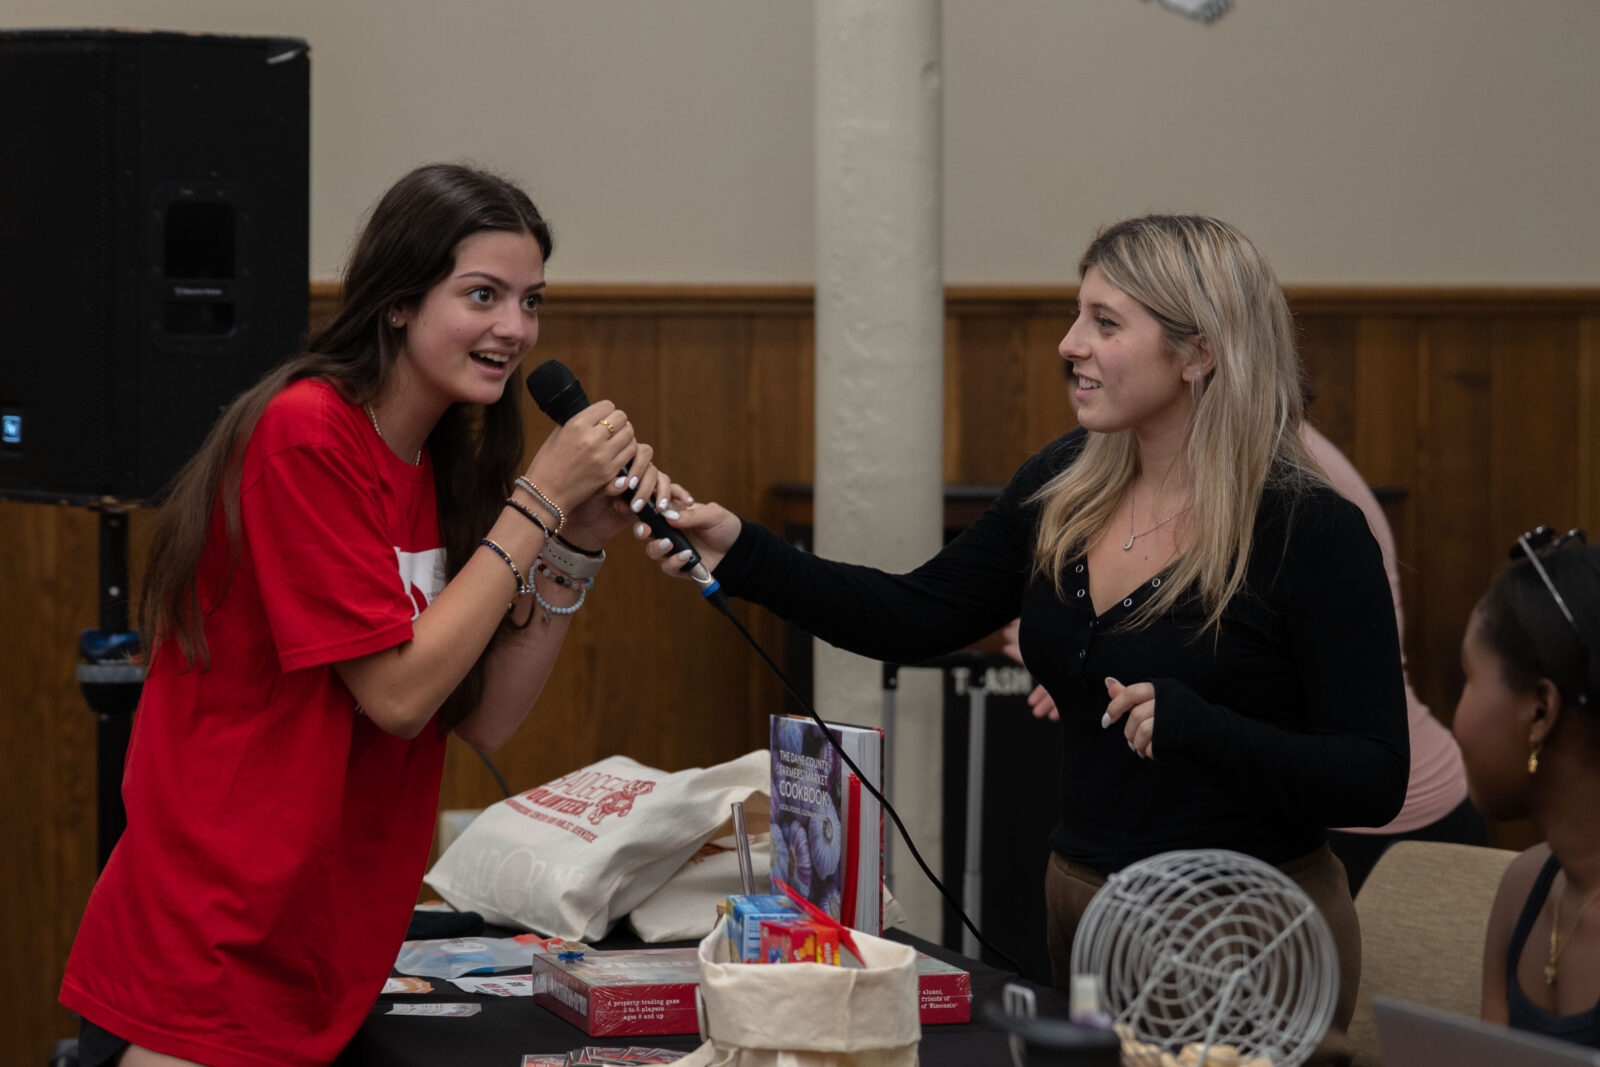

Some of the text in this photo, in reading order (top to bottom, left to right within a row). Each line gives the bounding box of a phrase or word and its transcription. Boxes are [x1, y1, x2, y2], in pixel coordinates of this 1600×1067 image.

[952, 665, 1033, 696] TASH
[780, 750, 828, 770] THE DANE COUNTY
[805, 769, 828, 786] MARKET
[779, 779, 828, 807] COOKBOOK
[570, 825, 599, 844] SERVICE
[641, 1006, 665, 1014] players
